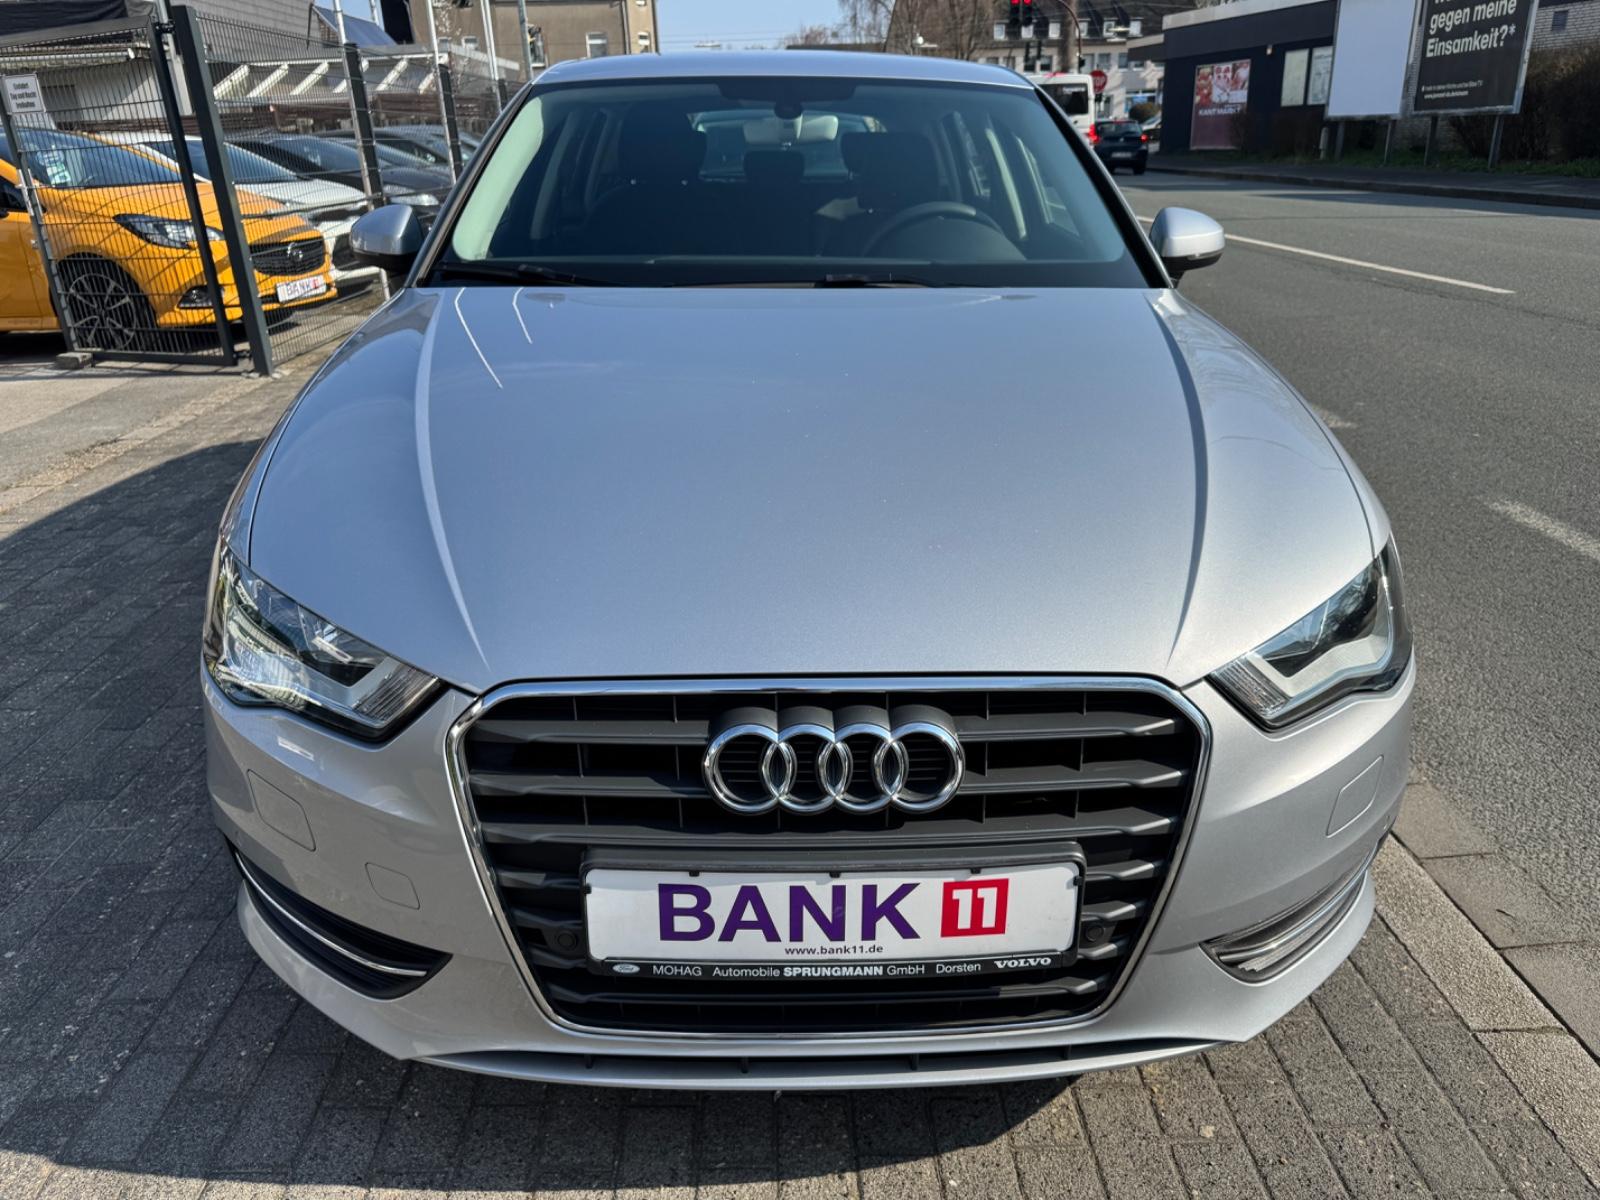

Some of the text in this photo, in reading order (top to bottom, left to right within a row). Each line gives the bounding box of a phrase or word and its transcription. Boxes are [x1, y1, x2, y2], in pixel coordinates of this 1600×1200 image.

[1429, 0, 1517, 35] gegen meine
[658, 883, 1001, 942] BANK 11
[784, 944, 884, 956] www.bank11.de
[652, 964, 702, 977] MOHAG
[712, 966, 780, 978] Automobile
[783, 965, 883, 977] SPRUNGMANN
[887, 964, 925, 976] GmbH
[936, 961, 981, 975] Dorsten
[994, 956, 1051, 970] VOLVO
